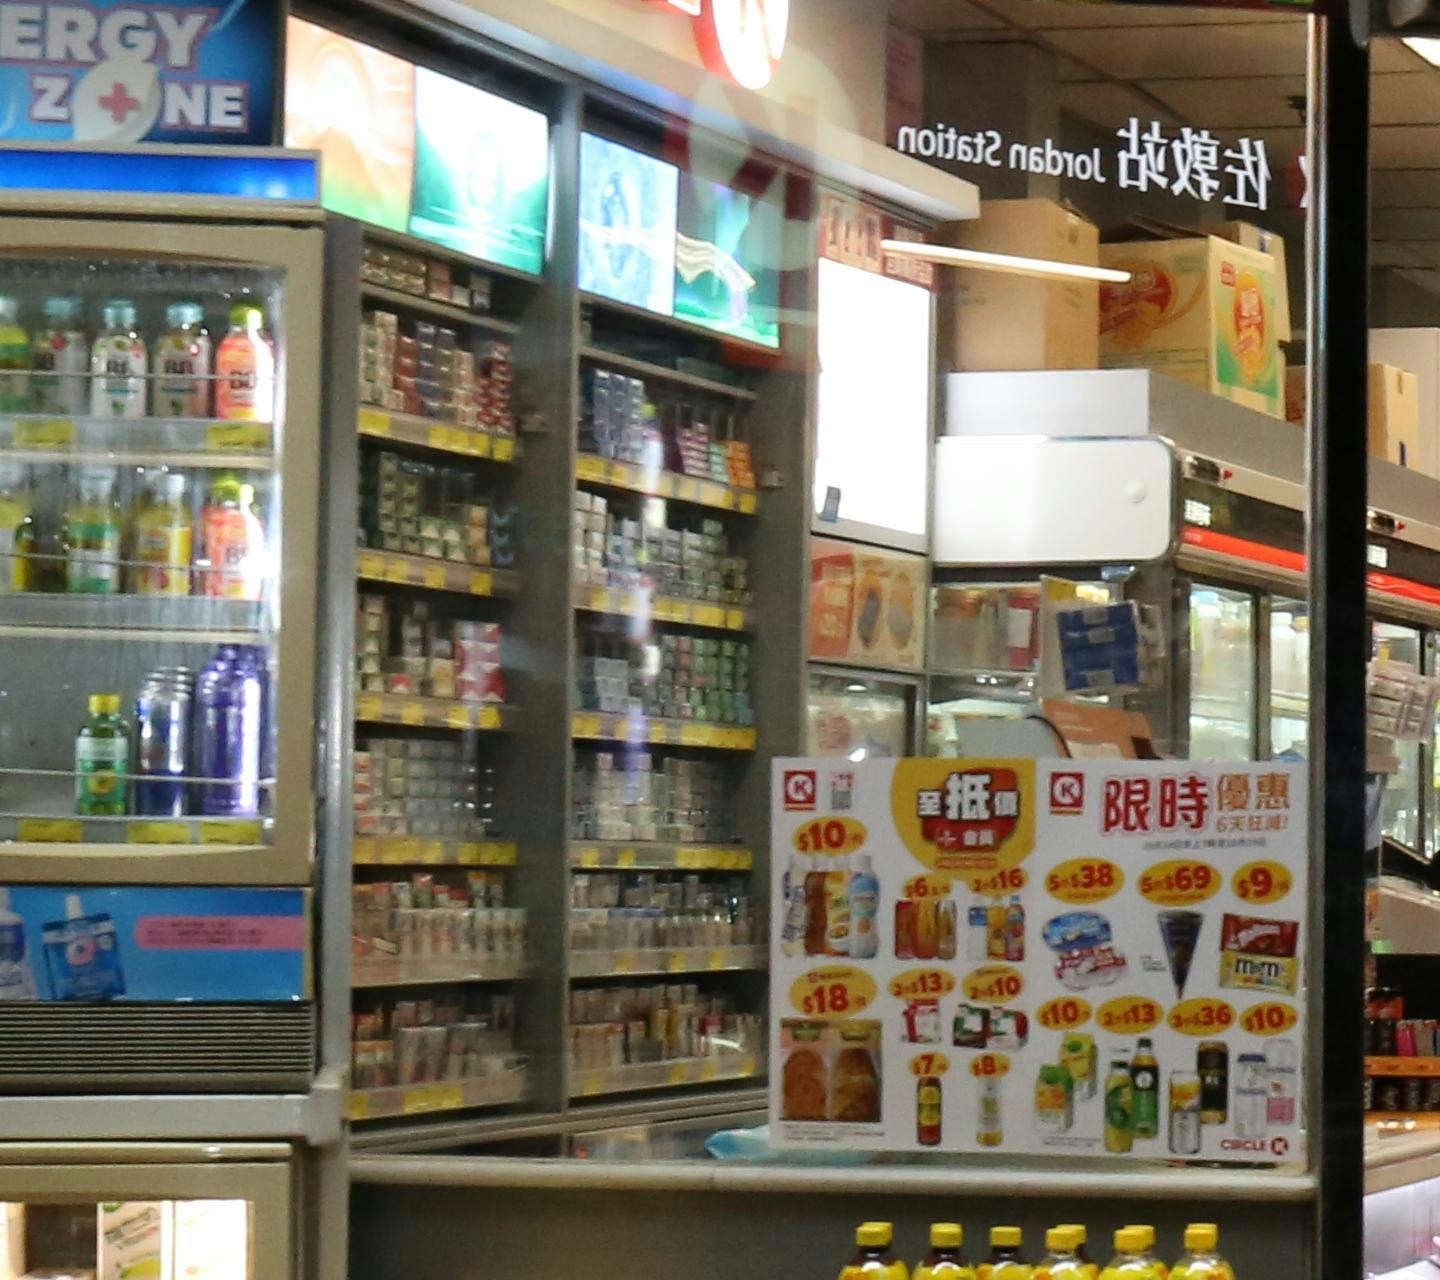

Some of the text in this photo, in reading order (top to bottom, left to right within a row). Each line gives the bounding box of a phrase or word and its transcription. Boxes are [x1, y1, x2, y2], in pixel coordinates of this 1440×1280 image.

[798, 821, 847, 852] $10
[1237, 867, 1273, 899] $9
[803, 983, 850, 1014] $18
[1220, 1140, 1268, 1153] CIRCLE
